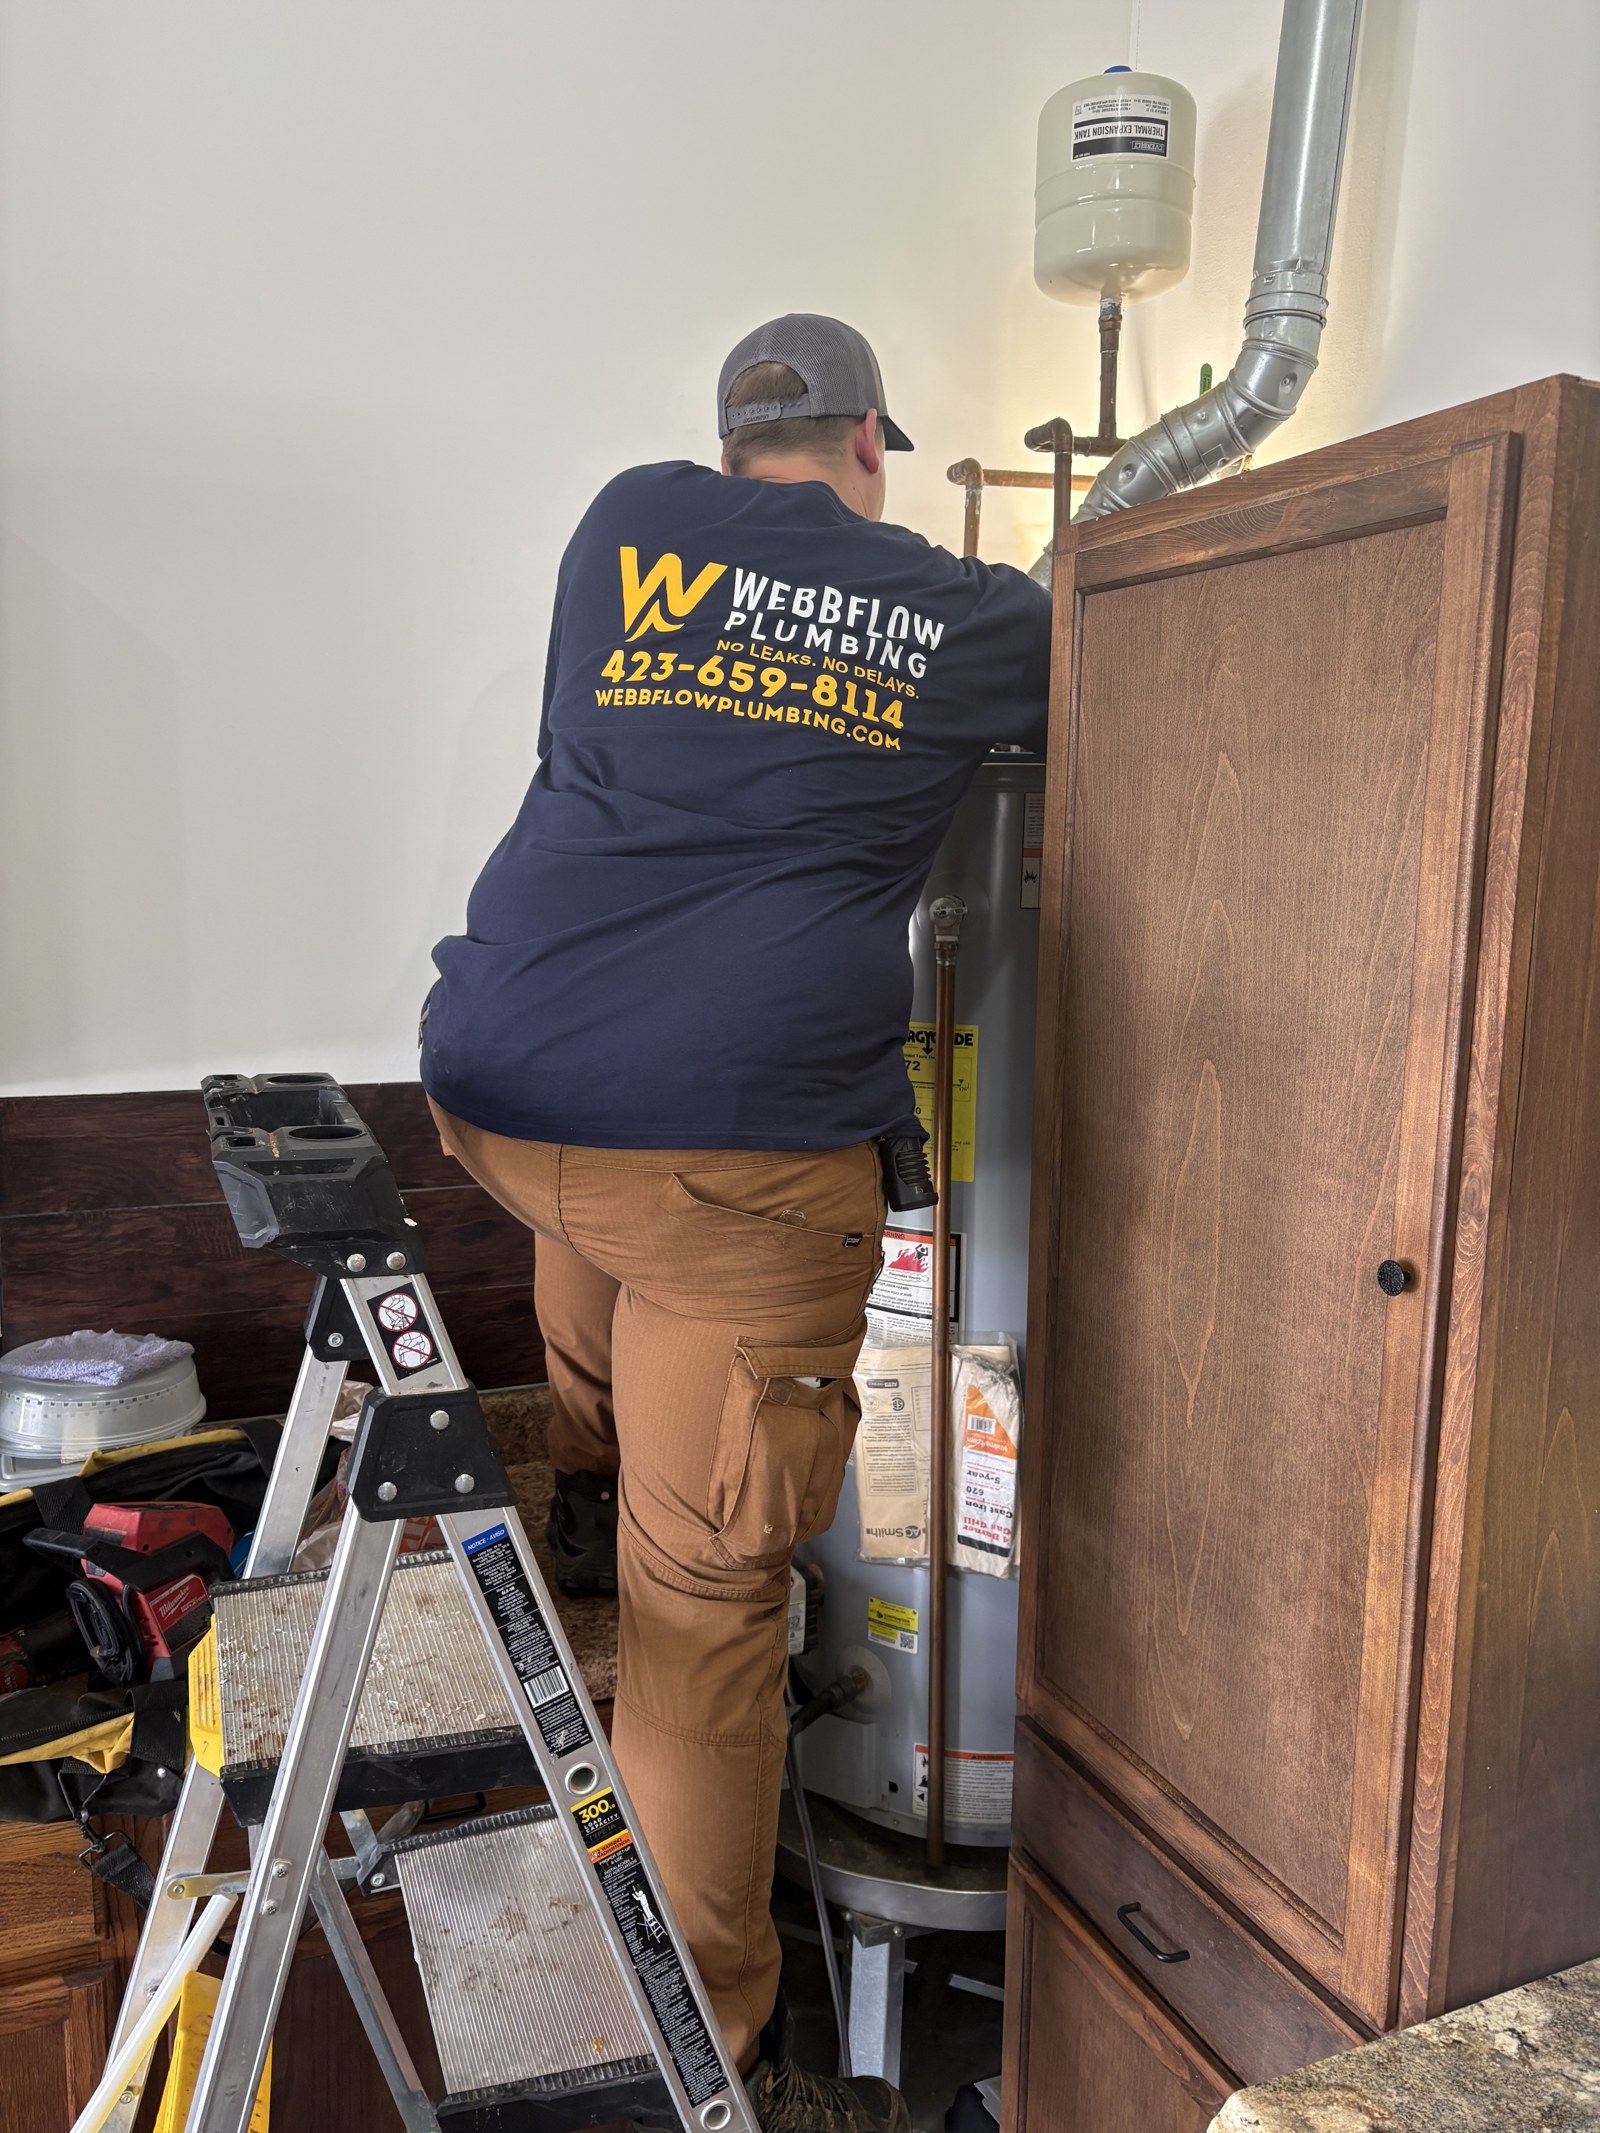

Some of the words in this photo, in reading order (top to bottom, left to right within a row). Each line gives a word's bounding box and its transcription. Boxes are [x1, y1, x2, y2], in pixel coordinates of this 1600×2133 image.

[1074, 128, 1090, 140] TANK
[1092, 124, 1133, 135] EXPANSION
[1134, 125, 1164, 137] THERMAL
[732, 567, 945, 651] WEBBFLOW
[723, 610, 927, 679] PLUMBING
[716, 639, 744, 652] NO
[749, 643, 817, 667] LEAKS.
[822, 656, 849, 674] NO
[854, 665, 920, 700] DELAYS.
[600, 649, 904, 730] 423-659-8114
[594, 688, 901, 751] WEBBFLOWPLUMBING.COM
[966, 1436, 1008, 1453] Walmart.com
[966, 1470, 1001, 1485] 5-year
[966, 1485, 984, 1496] 670
[965, 1500, 987, 1513] iron
[989, 1506, 1013, 1519] Cast
[963, 1516, 988, 1529] Grill
[991, 1523, 1012, 1536] Gas
[467, 1538, 487, 1551] NOTICE
[489, 1528, 505, 1541] AVISO
[962, 1525, 1000, 1540] Burner
[1002, 1535, 1009, 1544] 4
[158, 1585, 190, 1618] Milwaukee
[578, 1799, 610, 1824] 300
[583, 1817, 602, 1830] LOAD
[585, 1813, 618, 1834] CAPACITY
